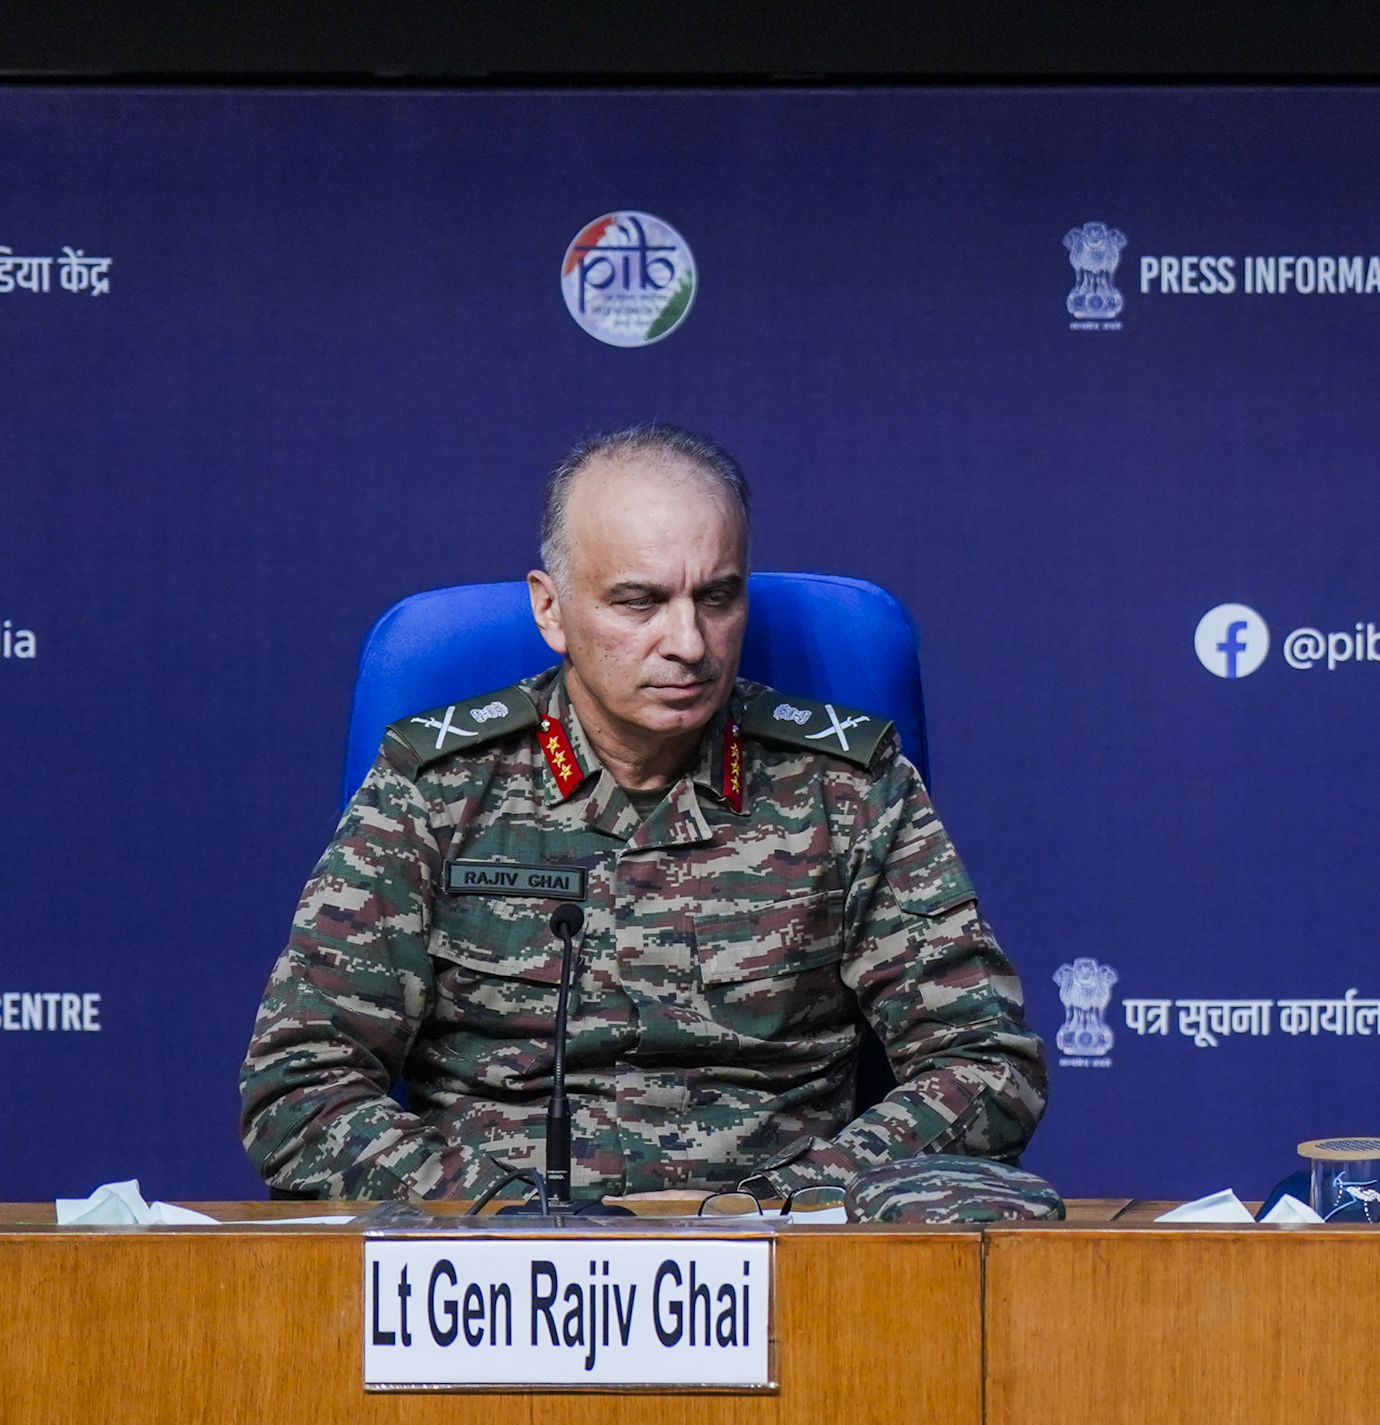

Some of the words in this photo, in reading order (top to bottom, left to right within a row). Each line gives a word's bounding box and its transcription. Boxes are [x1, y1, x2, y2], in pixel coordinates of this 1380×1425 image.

[57, 246, 113, 297] केंद्र
[1140, 255, 1235, 294] PRESS
[464, 870, 519, 888] RAJIV
[528, 873, 570, 890] GHAI
[0, 992, 101, 1032] ENTRE
[1123, 998, 1169, 1037] पत्र
[1175, 998, 1273, 1047] सूचना
[372, 1260, 412, 1348] Lt
[427, 1258, 512, 1348] Gen
[530, 1259, 637, 1371] Rajiv
[652, 1259, 750, 1348] Ghai
